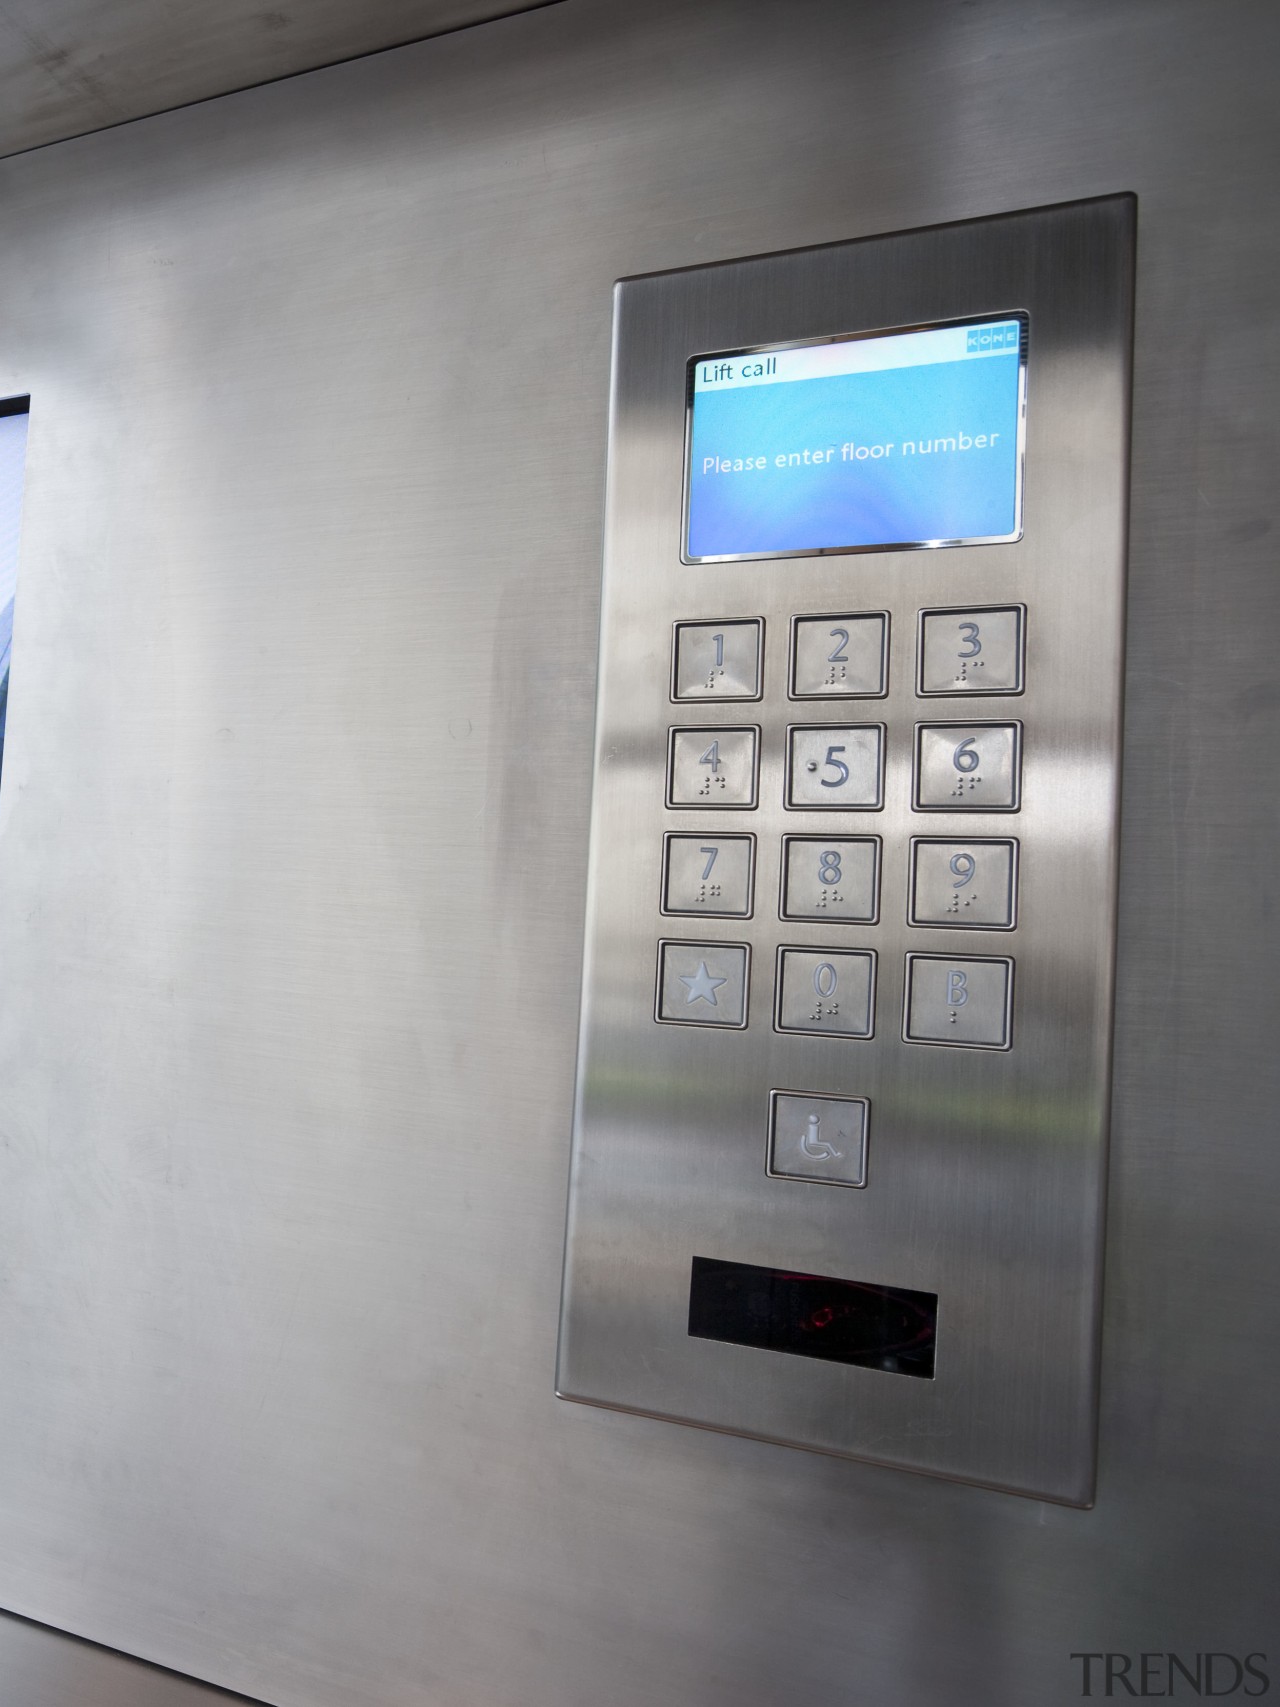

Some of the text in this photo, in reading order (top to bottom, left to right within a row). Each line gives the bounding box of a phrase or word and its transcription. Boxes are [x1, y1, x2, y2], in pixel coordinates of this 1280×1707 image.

[967, 329, 1017, 349] KONE
[703, 357, 777, 383] Lift call
[702, 431, 1000, 475] Please enter floor number
[711, 633, 724, 667] 1
[827, 628, 850, 662] 2
[957, 622, 982, 658] 3
[699, 740, 721, 773] 4
[820, 746, 849, 788] 5
[952, 737, 980, 773] 6
[700, 847, 719, 881] 7
[818, 850, 842, 885] 8
[949, 853, 976, 888] 9
[813, 962, 838, 998] 0
[946, 969, 969, 1007] B
